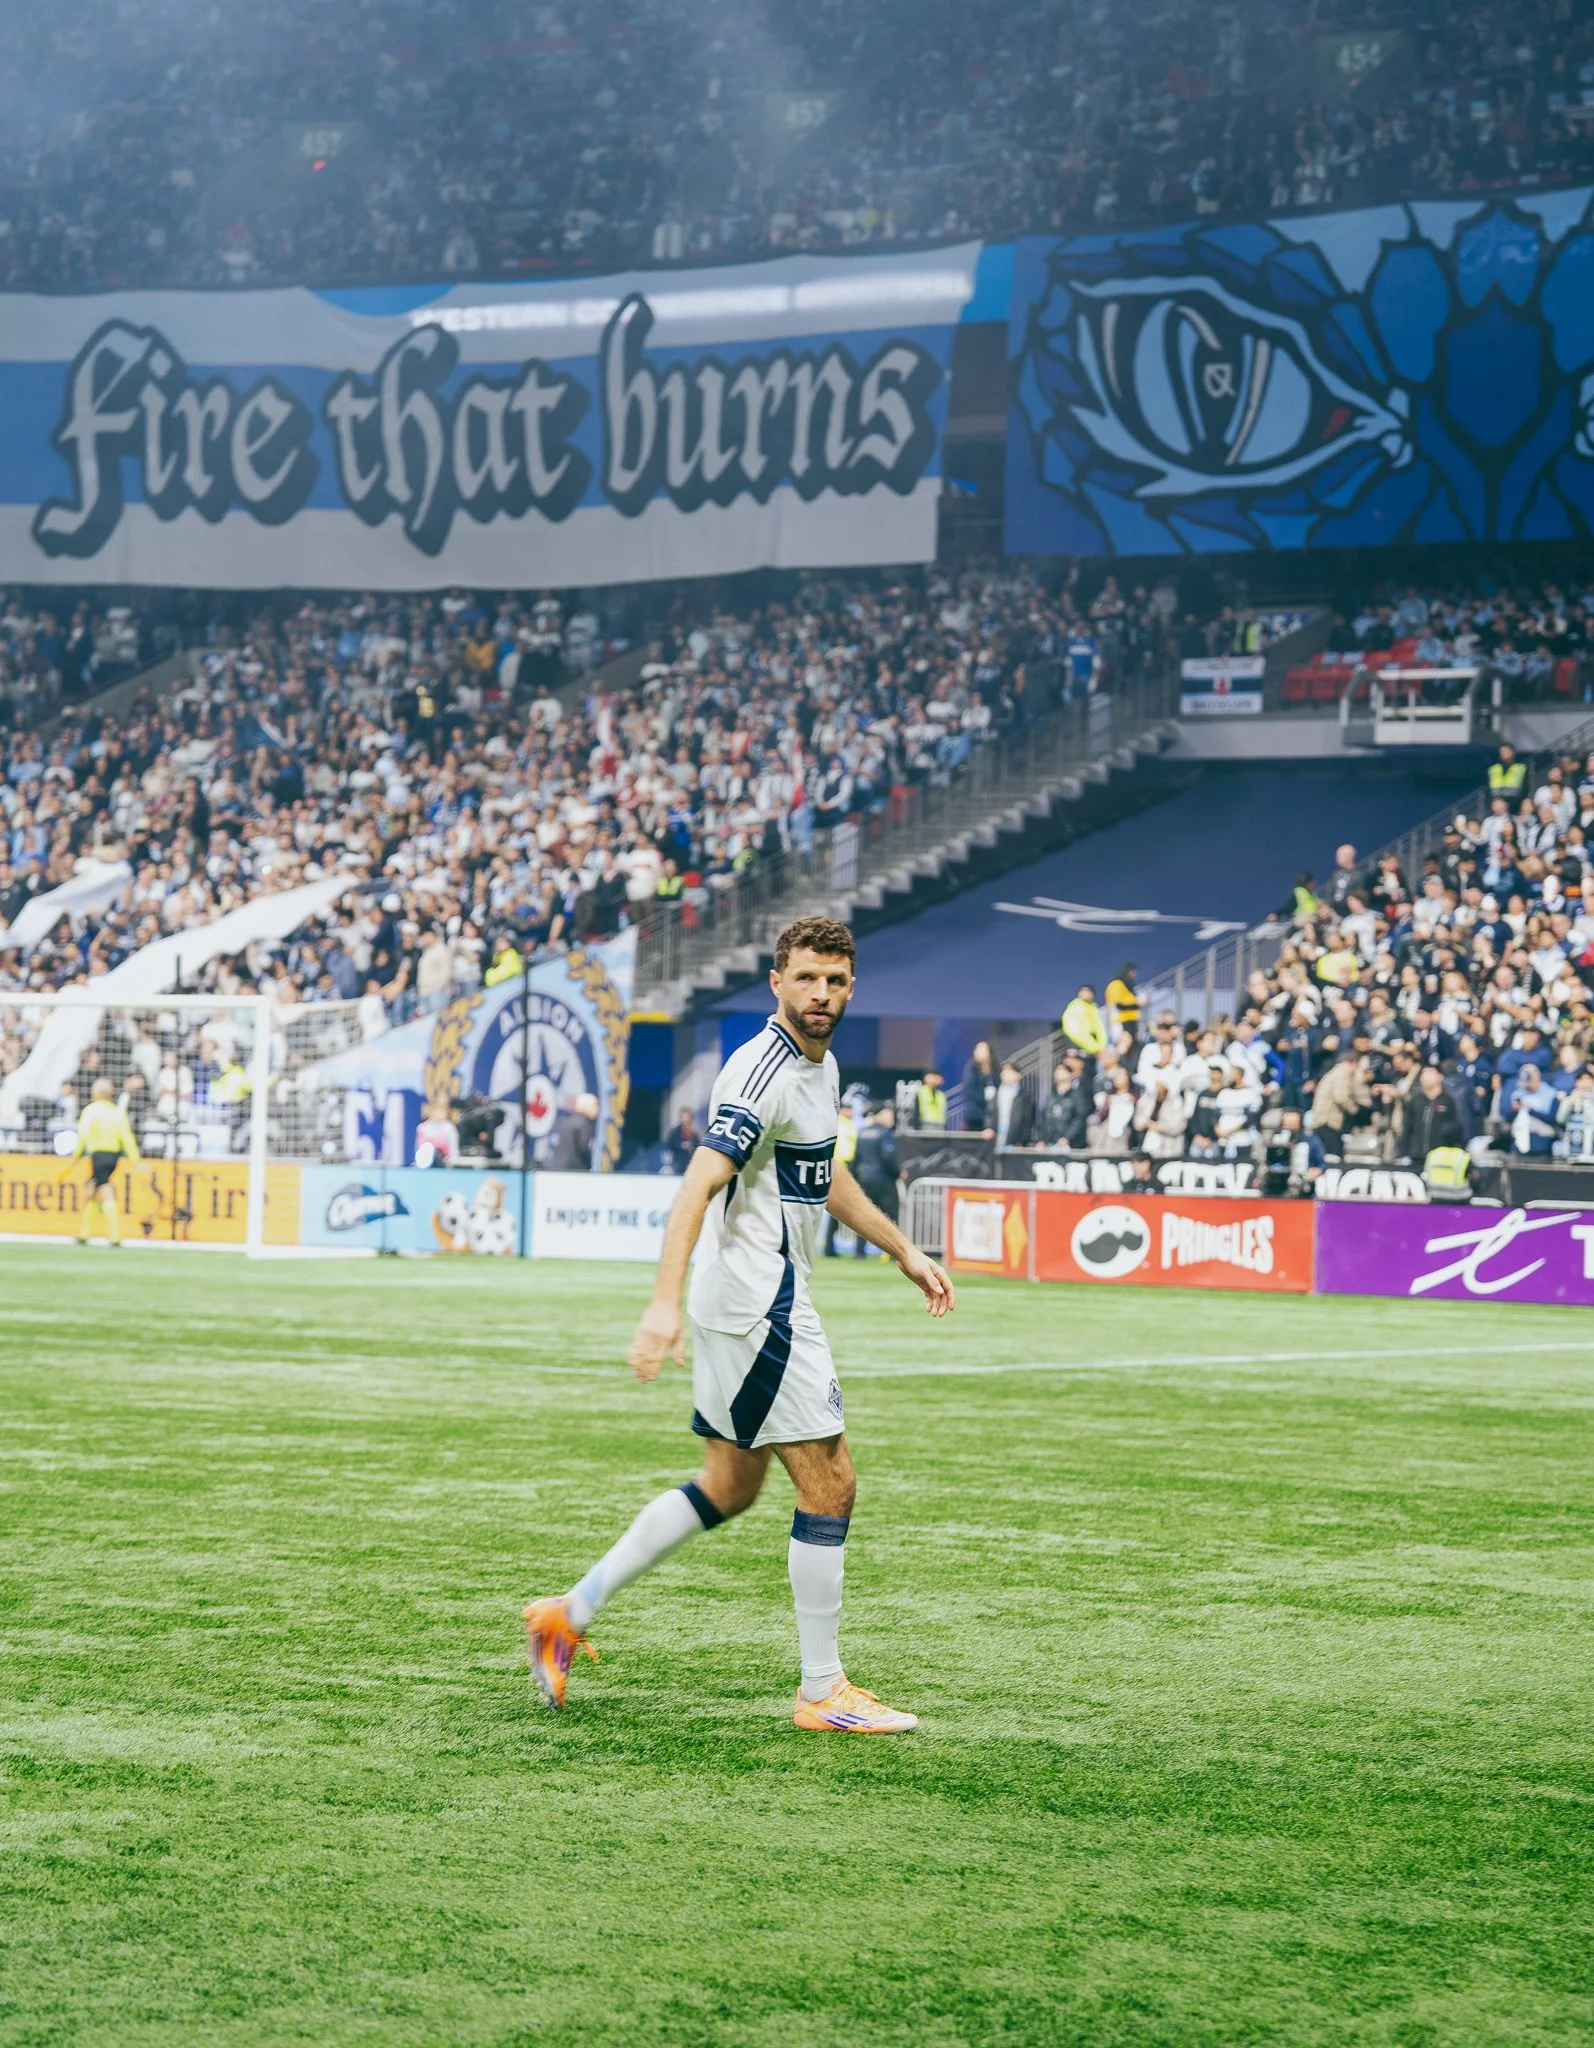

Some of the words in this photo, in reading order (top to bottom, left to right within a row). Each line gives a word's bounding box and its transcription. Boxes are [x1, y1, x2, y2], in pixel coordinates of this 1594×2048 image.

[33, 319, 316, 556] fire
[322, 324, 590, 555] that
[597, 292, 939, 516] burns
[498, 994, 585, 1045] ALBION
[174, 1170, 269, 1219] Tir
[546, 1207, 600, 1229] ENJOY
[607, 1208, 639, 1227] THE
[1160, 1210, 1275, 1275] PRINGLES
